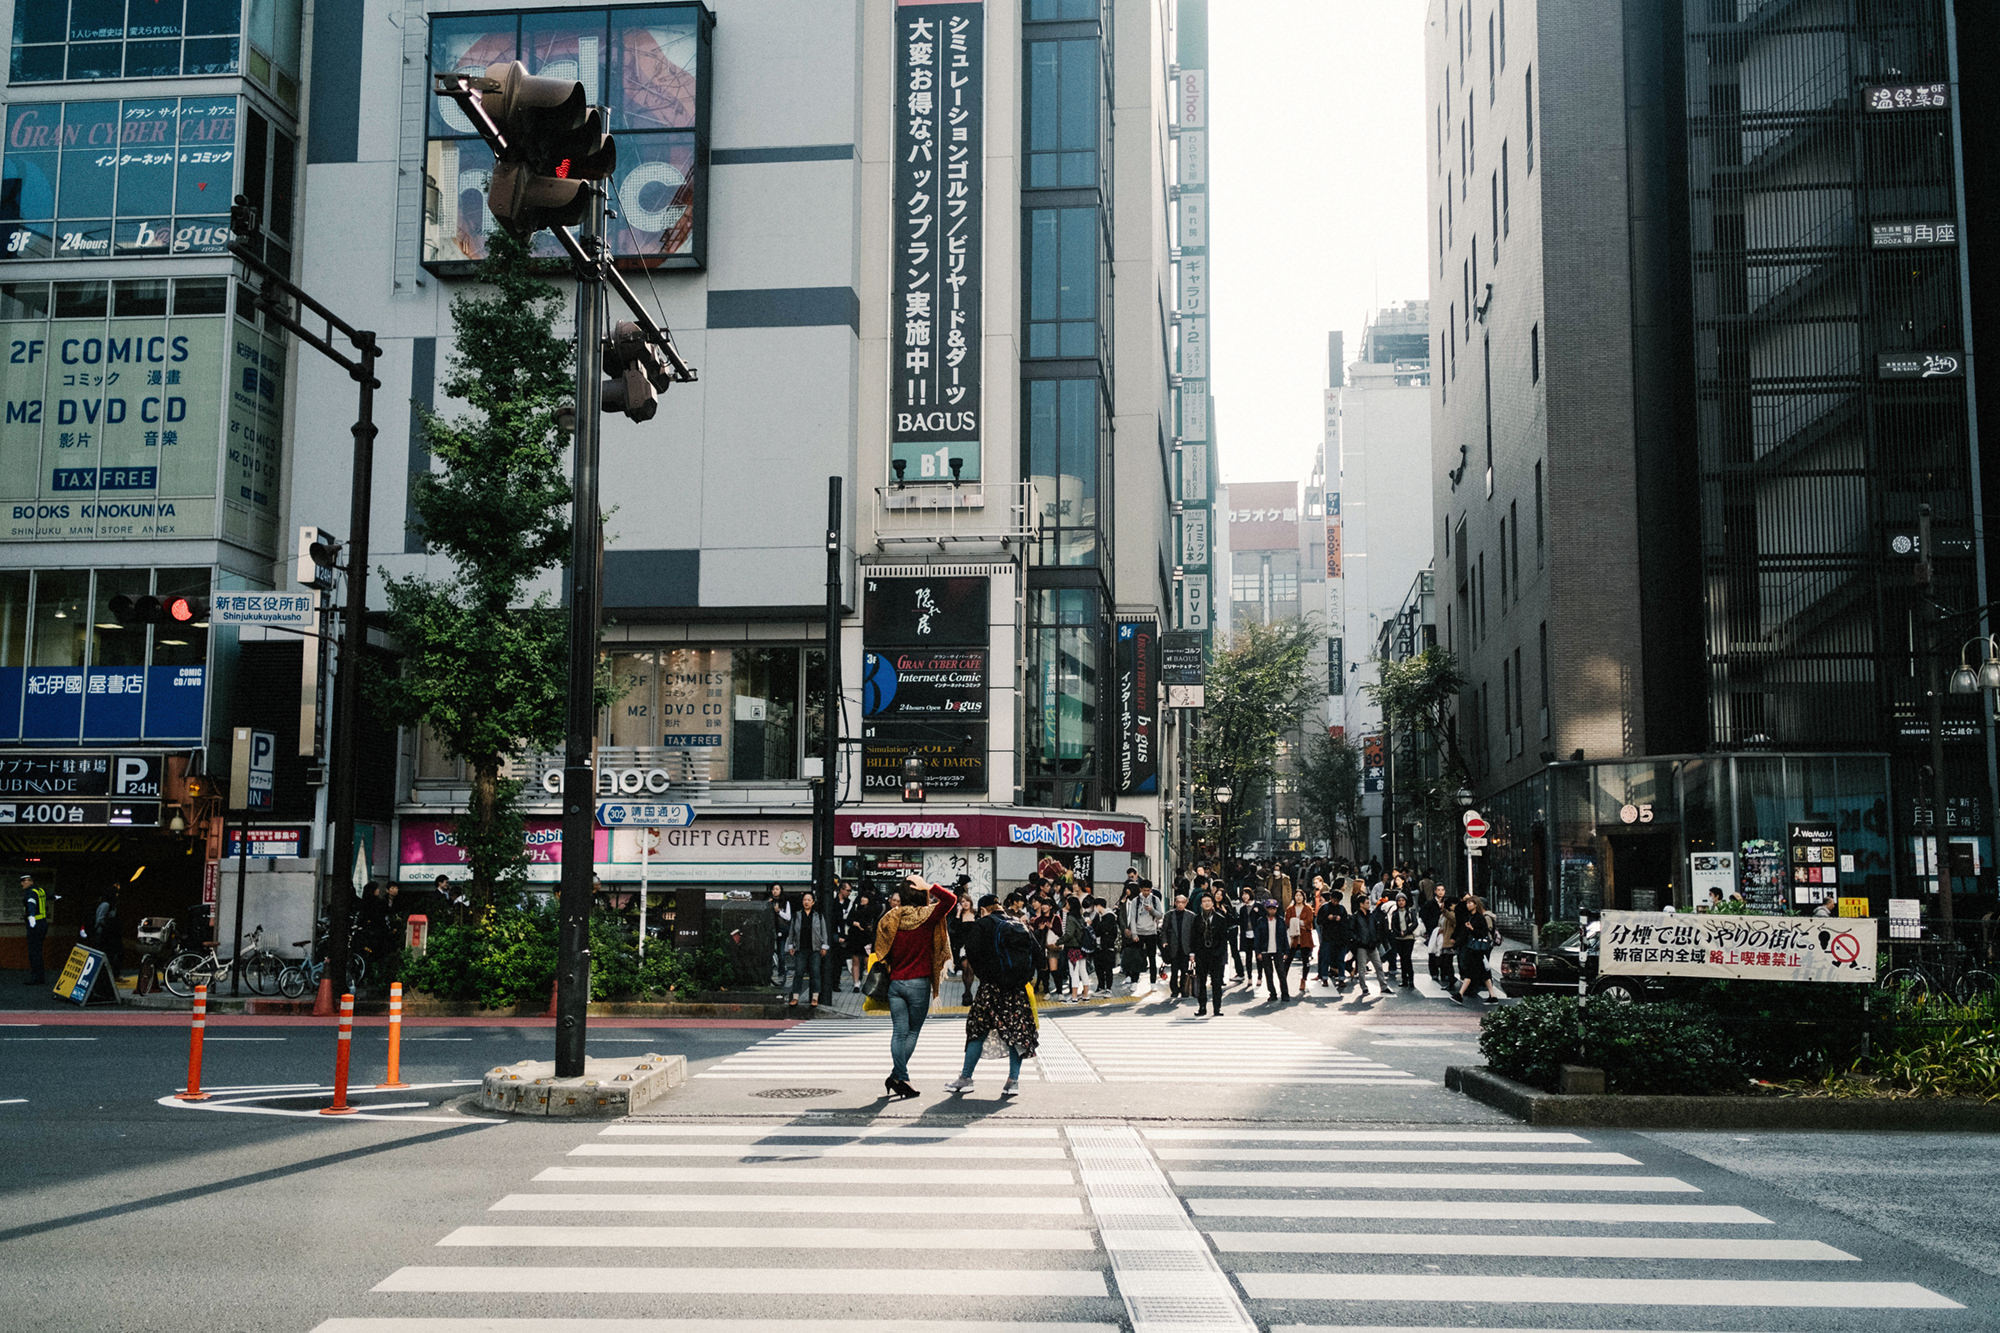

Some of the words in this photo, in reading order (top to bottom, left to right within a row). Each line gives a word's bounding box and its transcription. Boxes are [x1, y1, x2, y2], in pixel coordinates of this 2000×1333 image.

[1931, 84, 1944, 93] 6F
[126, 107, 154, 119] グラン
[208, 106, 235, 116] カフェ
[88, 121, 168, 145] CYBER
[180, 118, 236, 142] CAFE
[95, 152, 172, 168] インターネット
[191, 151, 232, 164] コミック
[1914, 224, 1956, 242] 角座
[7, 232, 31, 252] 3F
[60, 233, 108, 250] 24hours
[10, 340, 44, 364] 2F
[61, 336, 189, 365] COMICS
[63, 372, 120, 387] コミック
[6, 401, 42, 424] M2
[58, 399, 126, 425] DVD
[141, 397, 186, 424] CD
[898, 412, 976, 432] BAGUS
[59, 432, 92, 448] 影片
[921, 447, 949, 478] B1
[59, 472, 94, 487] TAX
[102, 470, 151, 487] FREE
[13, 505, 70, 519] BOOKS
[80, 504, 176, 518] KINOKUNIYA
[1186, 523, 1194, 562] ゲーム本
[1196, 524, 1204, 562] コミック
[216, 596, 310, 612] 新宿区役所前
[1190, 588, 1200, 626] DVD
[223, 612, 302, 622] Shinjukukuyakusho
[1120, 626, 1132, 638] 3F
[867, 654, 877, 664] 3F
[897, 654, 923, 670] GRAN
[928, 660, 958, 669] CYBER
[959, 660, 981, 669] CAFE
[179, 668, 202, 676] COMIC
[898, 673, 938, 682] Internet
[948, 672, 981, 682] Comic
[28, 675, 144, 694] 紀伊國屋書店
[174, 678, 202, 686] CD/DVD
[628, 706, 648, 716] M2
[665, 704, 694, 715] DVD
[703, 704, 722, 715] CD
[866, 727, 876, 738] B1
[1121, 672, 1132, 791] インターネット&コミック
[667, 736, 687, 745] TAX
[691, 736, 718, 745] FREE
[254, 736, 270, 766] P
[931, 758, 940, 768] &
[944, 758, 982, 768] DARTS
[116, 758, 149, 794] P
[0, 778, 78, 794] UBNADE
[129, 782, 158, 794] 24H
[249, 790, 262, 806] IN
[22, 804, 84, 823] 400台
[608, 809, 624, 820] 302
[631, 806, 681, 818] 靖国通り
[668, 830, 712, 847] GIFT
[717, 830, 770, 847] GATE
[850, 822, 960, 840] サーティワンアイスクリーム
[1009, 824, 1056, 845] baskin
[1056, 820, 1081, 848] BR
[1083, 829, 1124, 848] robbins
[977, 852, 990, 862] 8F
[1610, 924, 1815, 950] 分煙で思いやりの街に。
[1613, 948, 1706, 964] 新宿区内全域
[1709, 950, 1802, 968] 路上喫煙禁止
